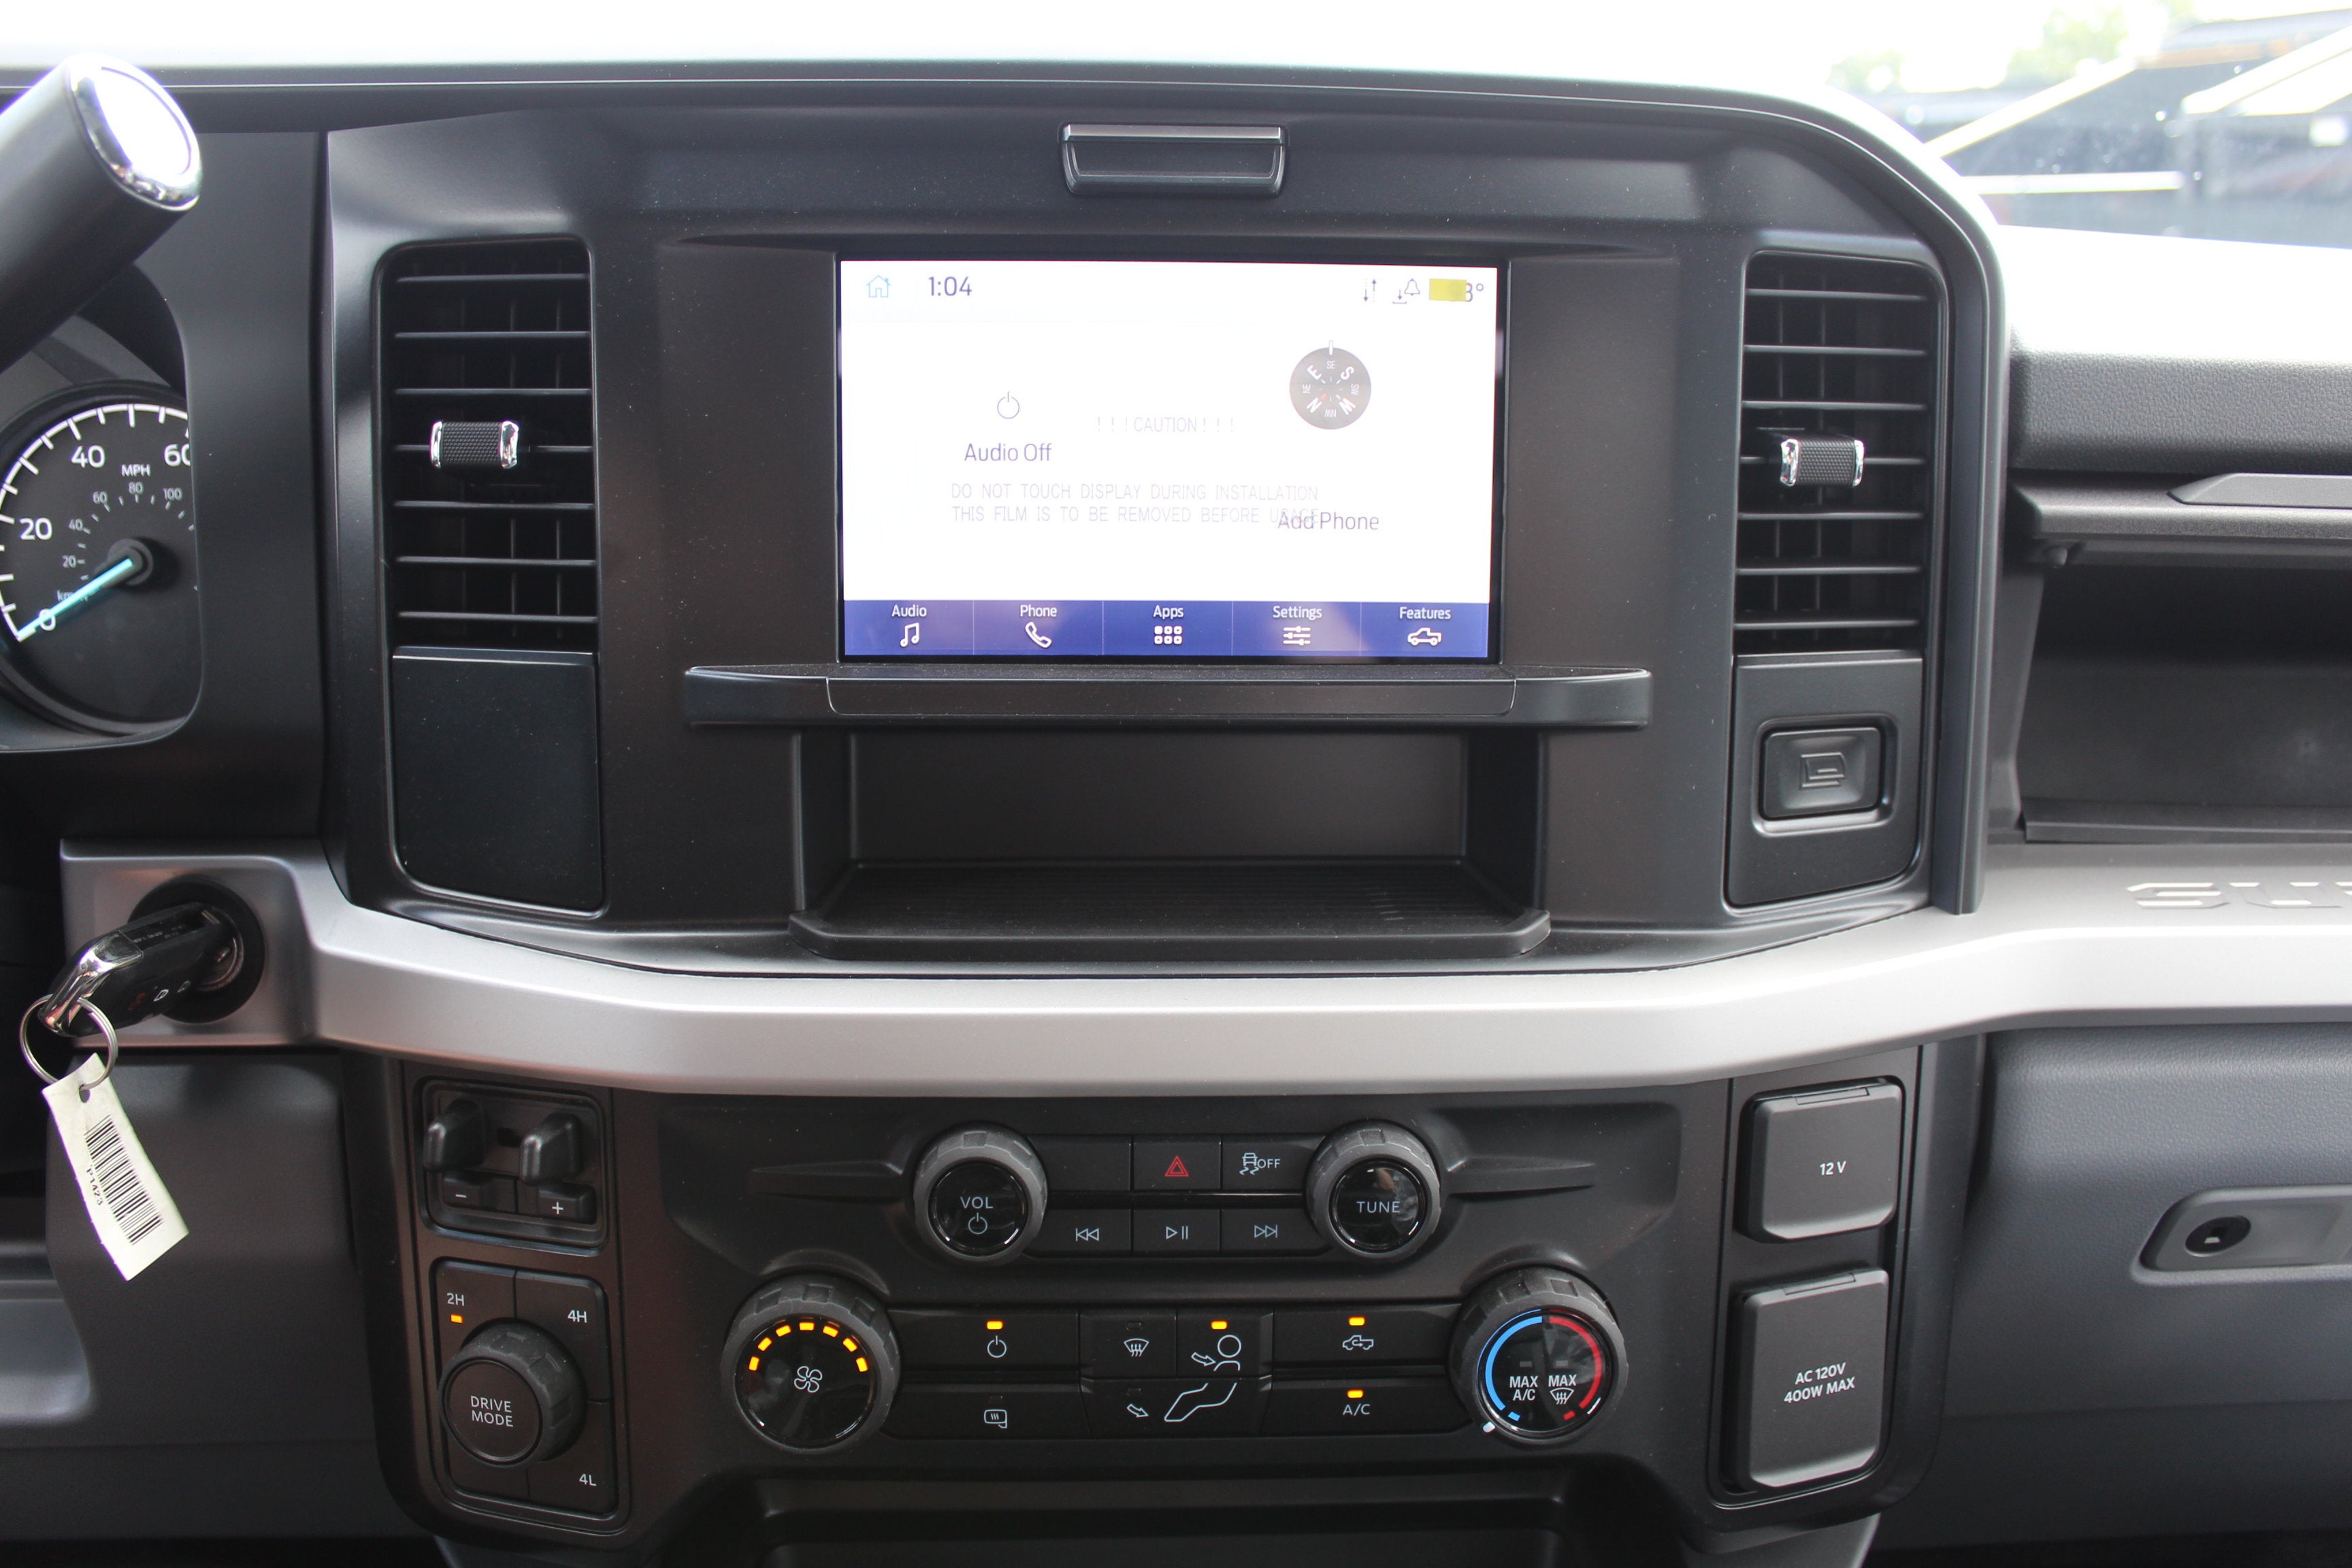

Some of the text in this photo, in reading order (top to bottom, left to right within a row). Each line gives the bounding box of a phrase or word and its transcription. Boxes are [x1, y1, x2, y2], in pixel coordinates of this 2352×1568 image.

[929, 277, 972, 296] 1:04
[1307, 365, 1322, 380] E
[1340, 366, 1354, 380] S
[71, 446, 105, 468] 40
[964, 443, 1051, 461] Audio Off
[122, 464, 150, 476] MPH
[129, 482, 143, 495] 80
[163, 487, 183, 500] 100
[952, 483, 1318, 500] DO NOT TOUCH DISPLAY DURING INSTALLATION
[93, 491, 108, 504] 60
[953, 506, 984, 521] THIS
[995, 506, 1026, 521] FILM
[1037, 506, 1050, 521] IS
[1060, 506, 1078, 521] TO
[1090, 506, 1108, 521] BE
[1119, 506, 1190, 522] REMOVED
[1201, 507, 1259, 523] BEFORE
[1278, 511, 1379, 529] Add Phone
[20, 518, 52, 540] 20
[69, 519, 83, 530] 40
[63, 555, 77, 568] 20
[892, 604, 926, 617] Audio
[1021, 604, 1057, 617] Phone
[1154, 605, 1183, 619] Apps
[1273, 606, 1322, 620] Settings
[1400, 607, 1450, 619] Features
[1258, 1158, 1281, 1171] OFF
[1820, 1160, 1847, 1175] 12 V
[961, 1197, 993, 1209] VOL
[1357, 1201, 1400, 1213] TUNE
[447, 1293, 464, 1306] 2H
[568, 1310, 587, 1322] 4H
[1795, 1362, 1846, 1385] AC 120V
[1510, 1376, 1538, 1390] MAX
[1549, 1375, 1576, 1388] MAX
[1513, 1389, 1535, 1401] A/C
[1784, 1376, 1856, 1404] 400W MAX
[470, 1395, 512, 1413] DRIVE
[1343, 1403, 1370, 1416] A/C
[472, 1409, 513, 1427] MODE
[579, 1474, 596, 1486] 4L
